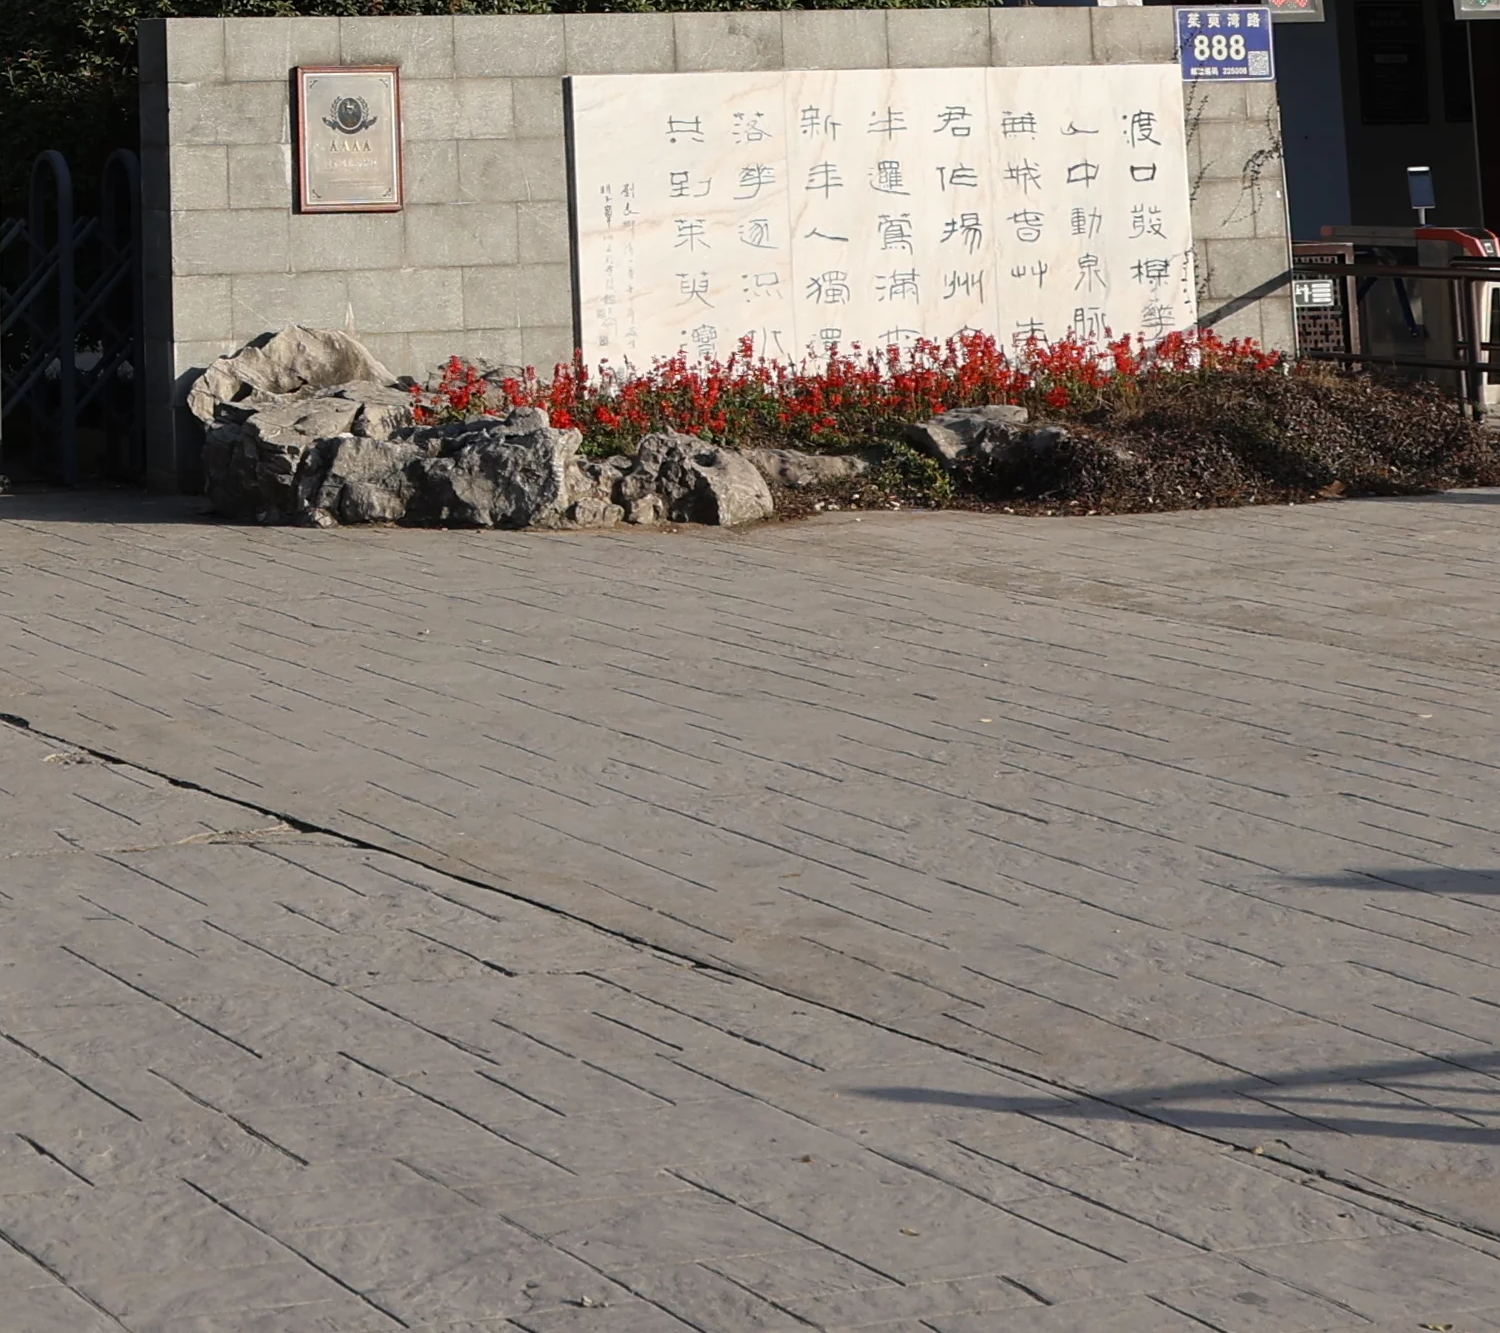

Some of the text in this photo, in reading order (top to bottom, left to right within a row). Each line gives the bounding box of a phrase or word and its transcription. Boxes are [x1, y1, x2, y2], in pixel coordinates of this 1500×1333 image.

[1187, 12, 1260, 28] 茱萸湾路
[1193, 34, 1246, 61] 888
